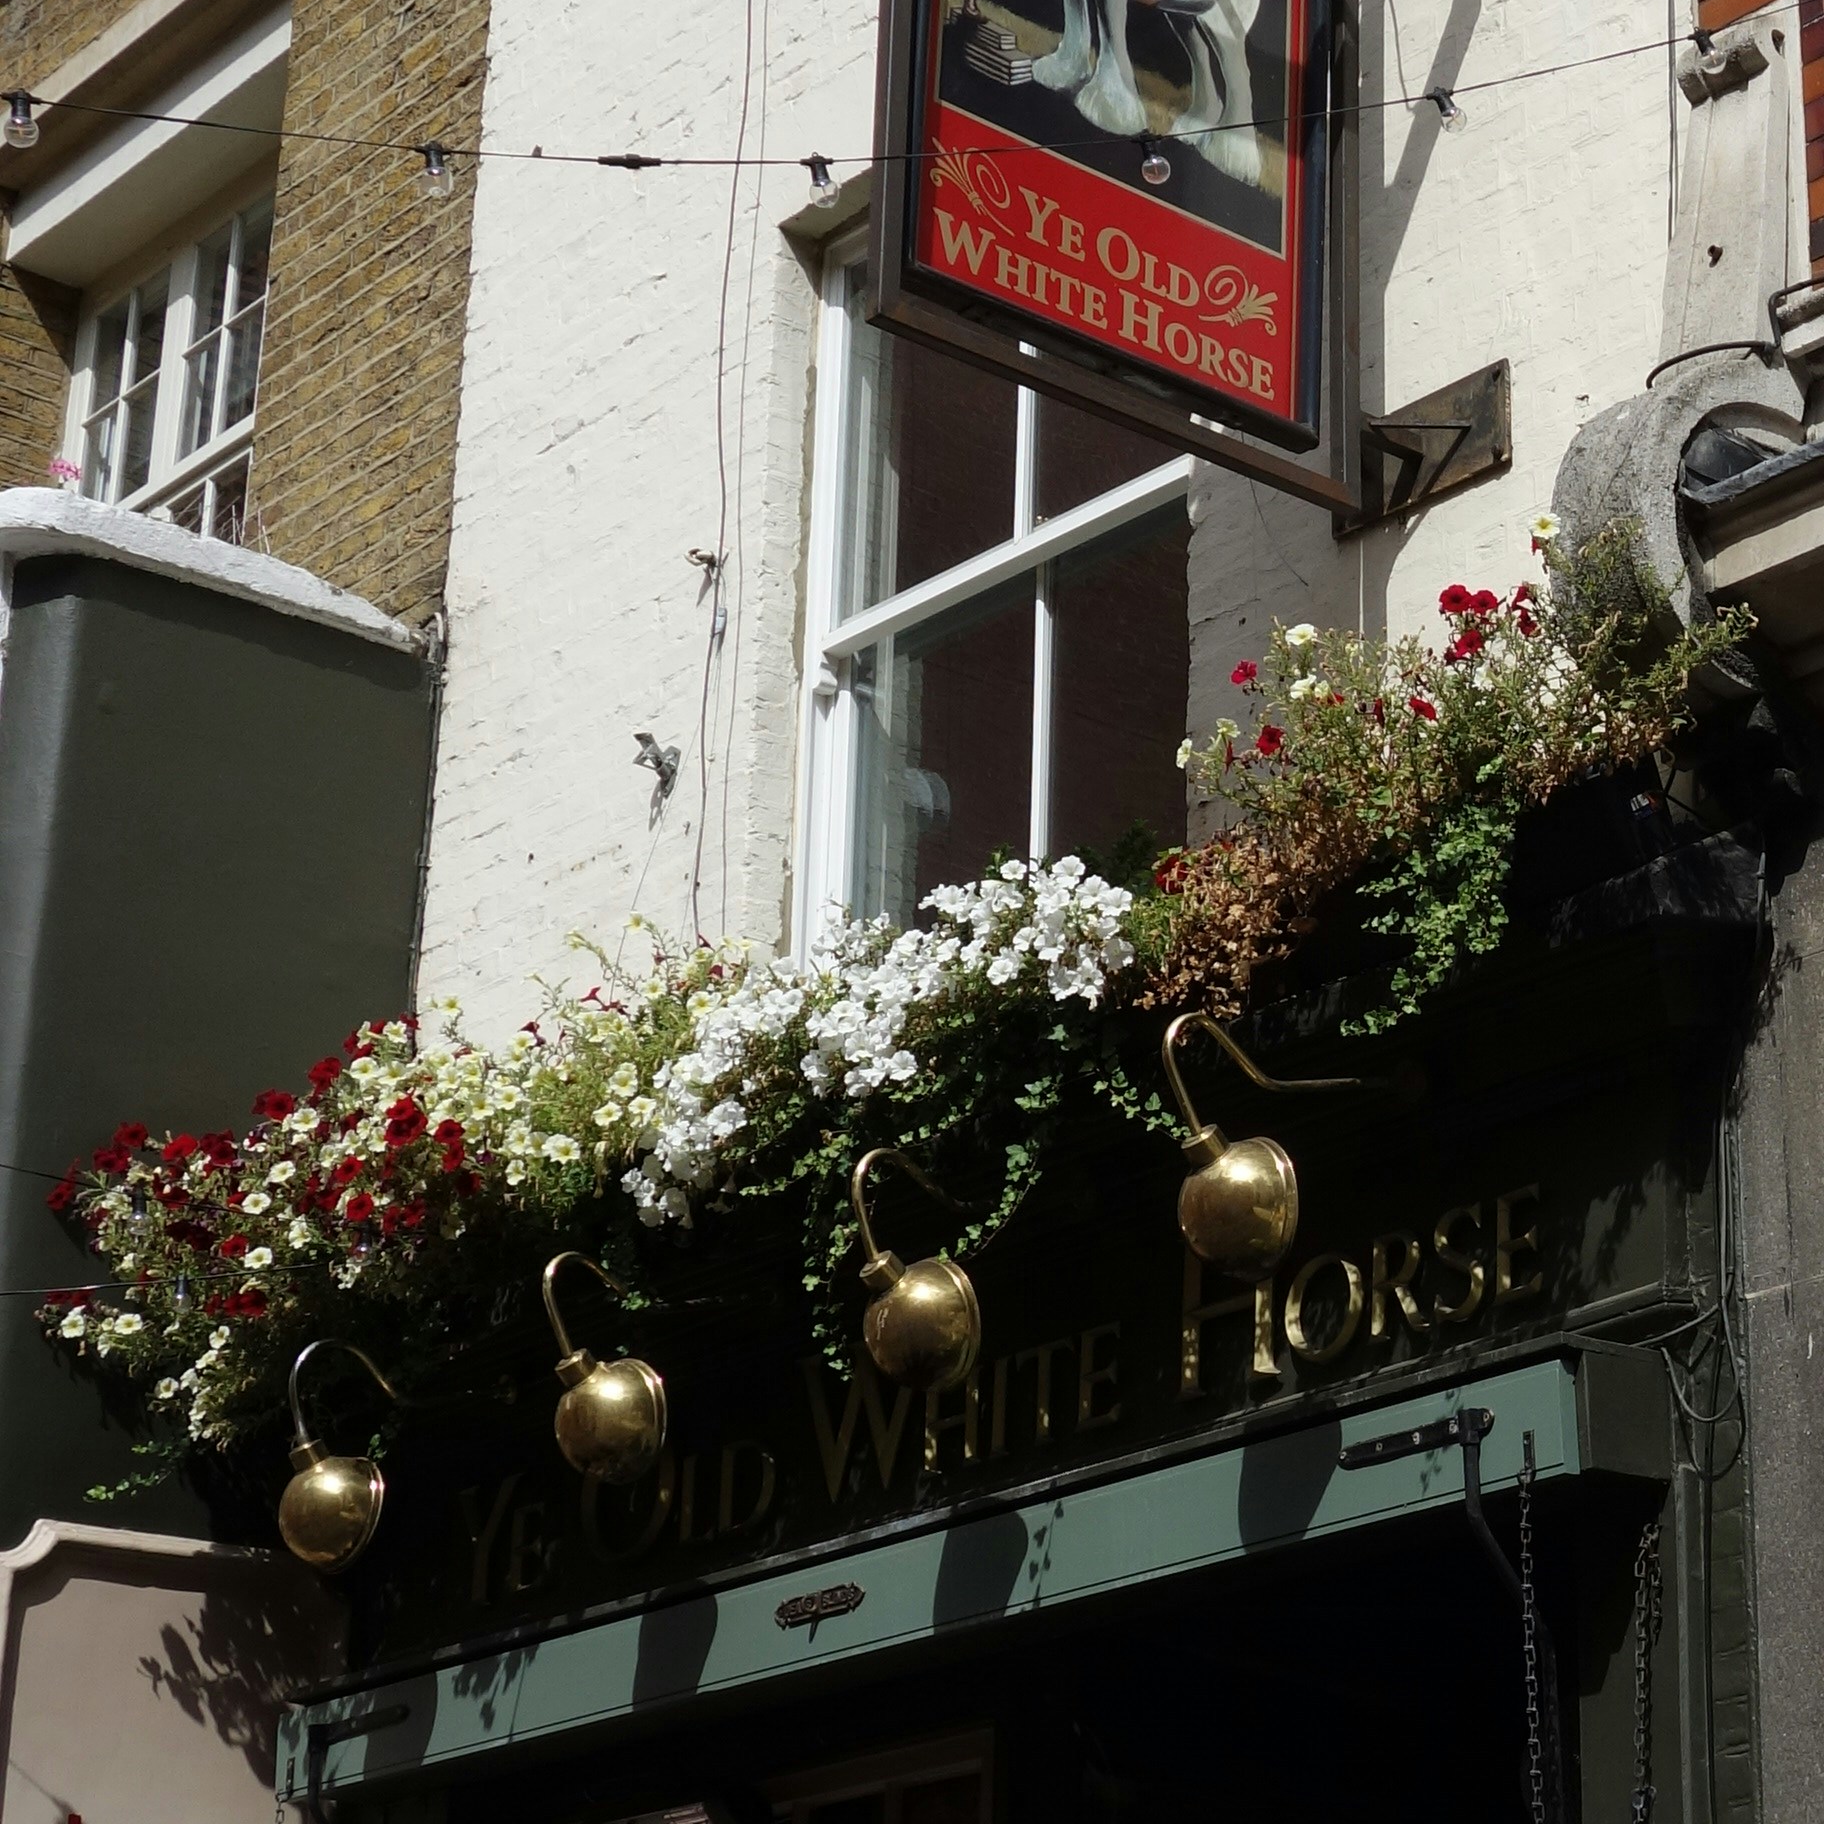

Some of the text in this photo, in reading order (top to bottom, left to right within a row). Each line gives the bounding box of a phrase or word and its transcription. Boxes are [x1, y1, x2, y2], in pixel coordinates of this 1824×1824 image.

[931, 206, 1275, 401] WHITE HORSE
[1096, 226, 1200, 308] OLD
